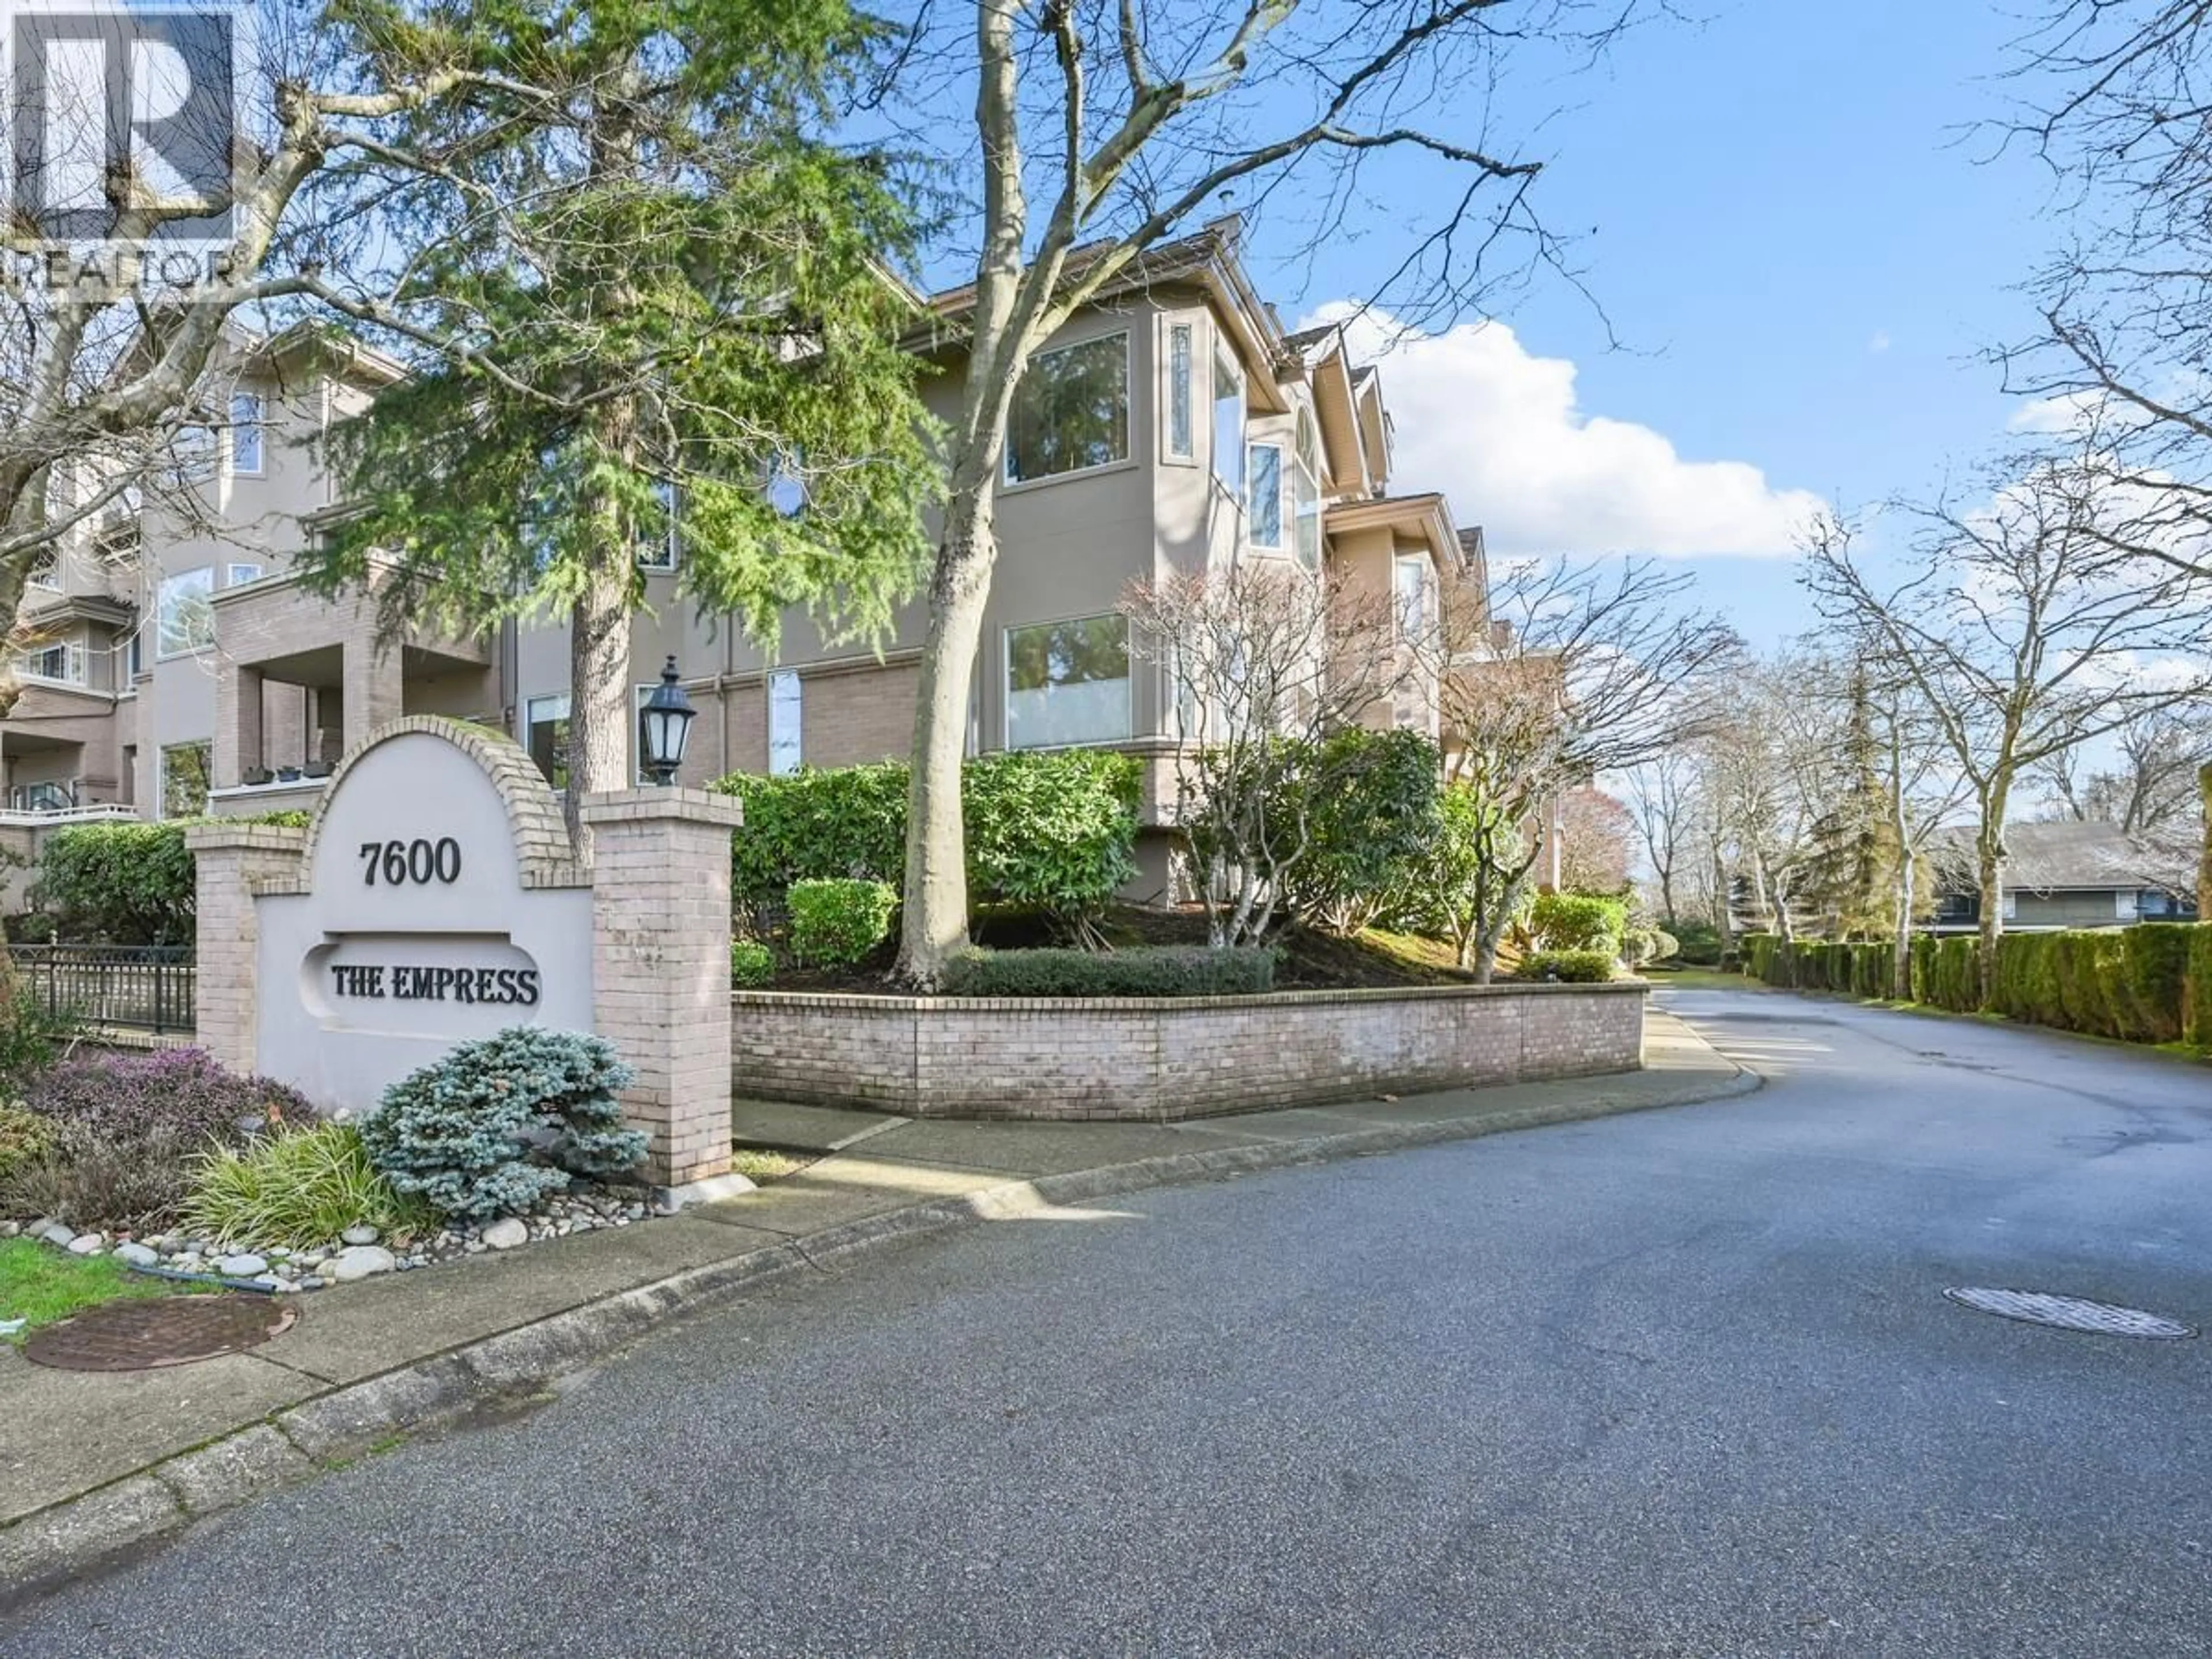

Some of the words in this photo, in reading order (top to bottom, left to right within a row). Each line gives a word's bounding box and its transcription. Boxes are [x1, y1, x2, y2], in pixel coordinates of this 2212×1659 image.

[359, 837, 461, 885] 7600
[332, 965, 385, 998] THE
[391, 966, 538, 1006] EMPRESS
